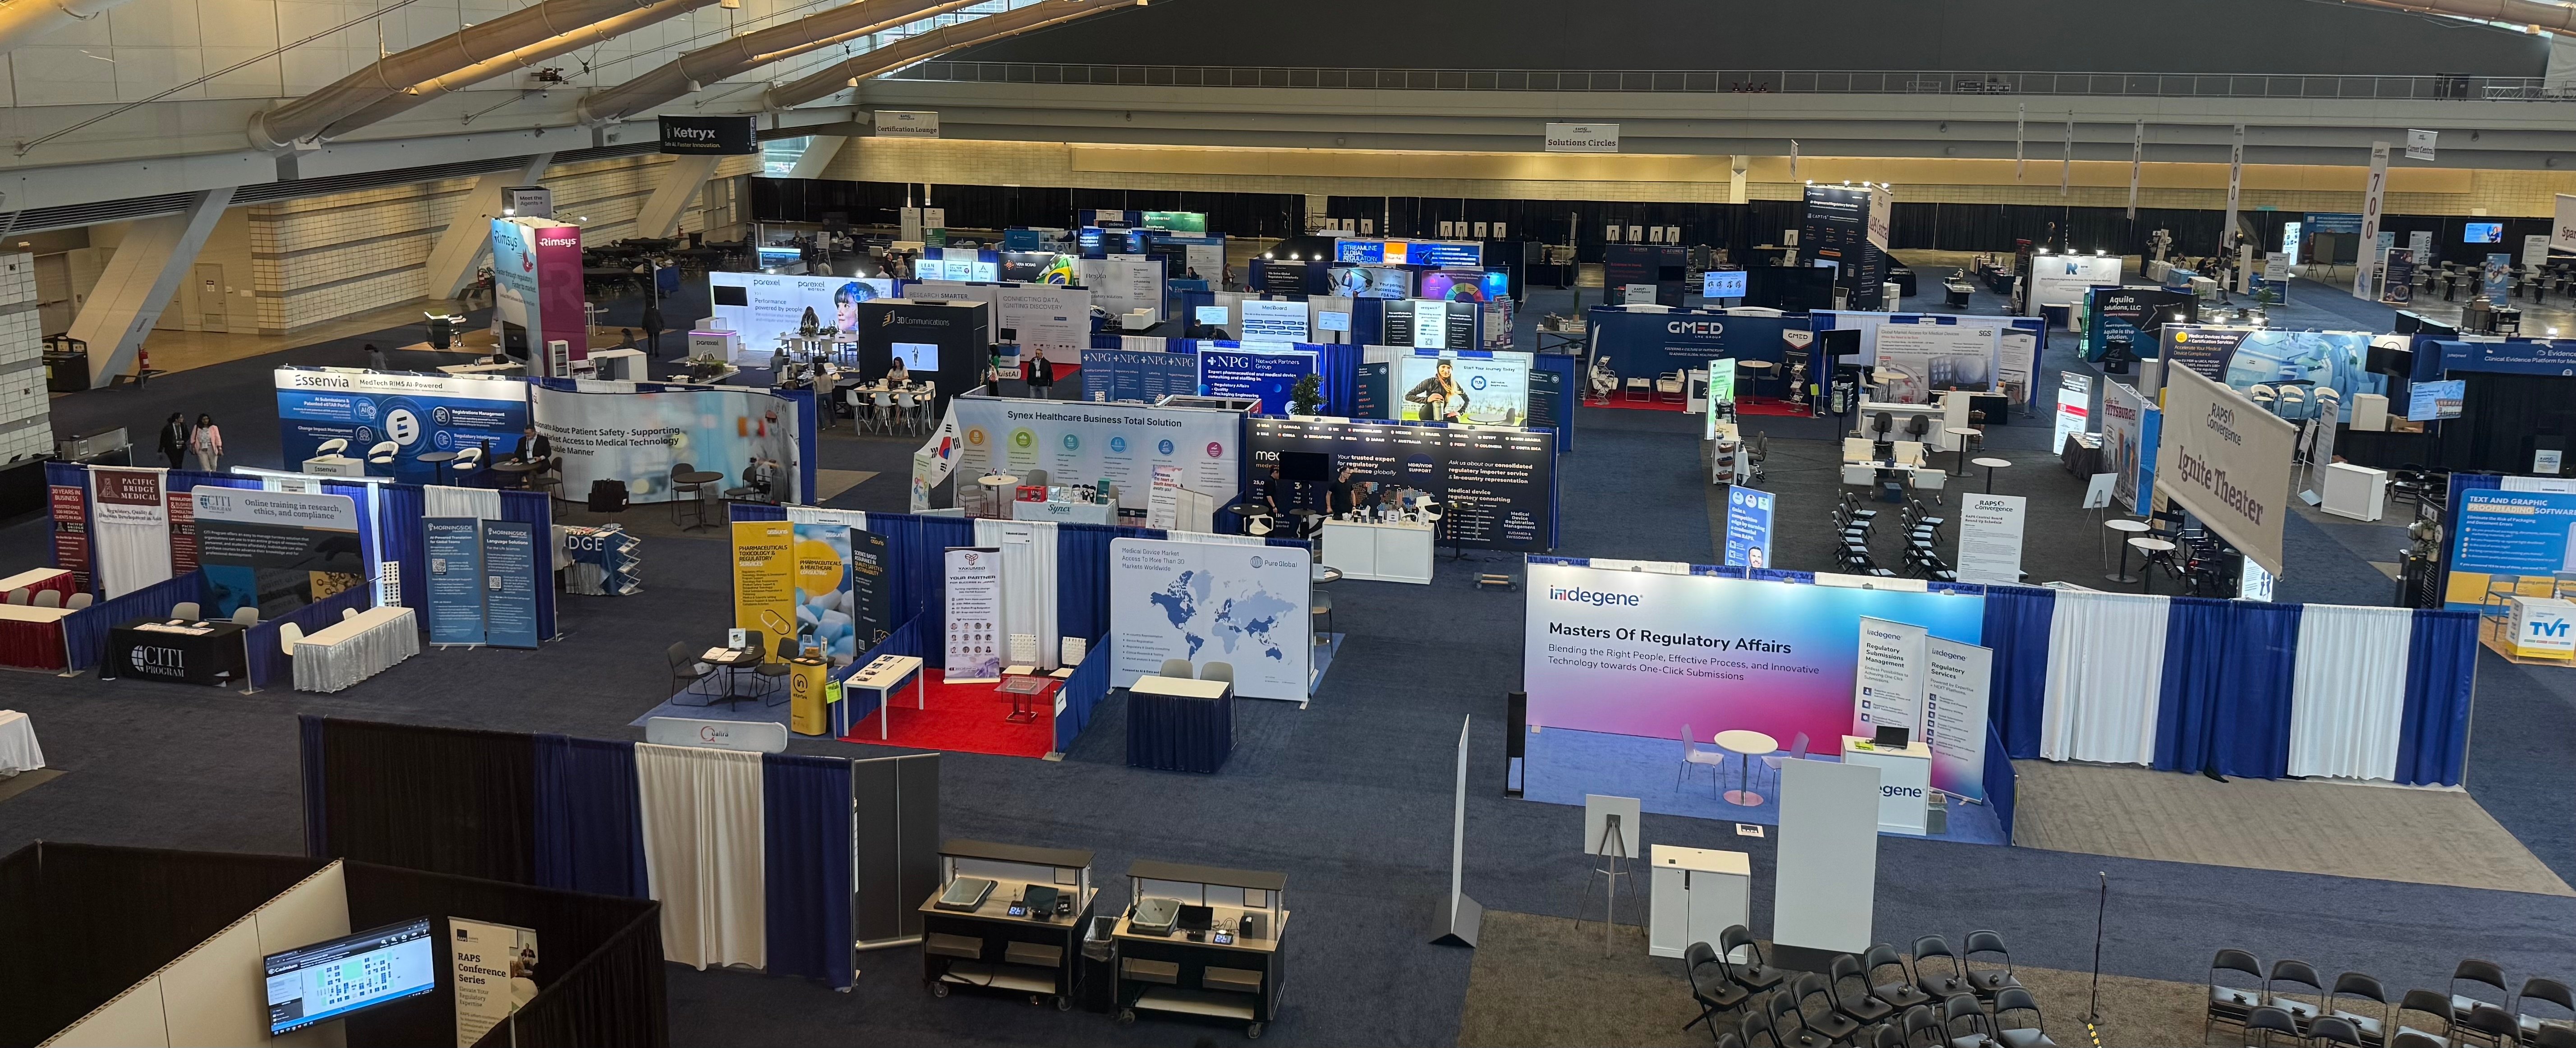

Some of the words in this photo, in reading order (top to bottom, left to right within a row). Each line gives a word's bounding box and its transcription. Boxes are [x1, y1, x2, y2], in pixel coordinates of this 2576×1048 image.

[674, 127, 715, 141] Ketryx
[2366, 173, 2380, 239] 700
[494, 231, 517, 251] Rimsys
[539, 238, 577, 247] Rimsys
[2110, 295, 2134, 305] Aquila
[1667, 321, 1723, 334] GMED
[1090, 353, 1111, 362] NPG
[1120, 354, 1139, 364] NPG
[1148, 355, 1167, 365] NPG
[1175, 357, 1194, 367] NPG
[1218, 356, 1248, 368] NPG
[296, 374, 349, 388] Essenvia
[2105, 404, 2136, 421] PITTSBURGH
[2212, 403, 2228, 423] RAPS
[1007, 411, 1033, 420] Synex
[1035, 412, 1081, 422] Healthcare
[1083, 414, 1122, 424] Business
[1124, 417, 1145, 425] Total
[1146, 418, 1182, 427] Solution
[552, 425, 570, 434] About
[571, 427, 598, 436] Patient
[599, 429, 625, 438] Safety
[631, 427, 680, 438] Supporting
[2207, 414, 2241, 446] Convergence
[563, 437, 584, 445] Access
[629, 437, 679, 446] Technology
[567, 447, 594, 456] Manner
[2178, 445, 2212, 489] Ignite
[2214, 468, 2263, 526] Theater
[208, 496, 230, 506] CITI
[270, 501, 298, 510] training
[308, 503, 341, 513] research,
[254, 508, 277, 517] ethics,
[294, 510, 335, 519] compliance
[1048, 504, 1071, 514] Synex
[1550, 585, 1641, 606] indegene
[2530, 618, 2570, 637] TVT
[1550, 622, 1610, 639] Masters
[1616, 628, 1636, 641] Of
[1641, 629, 1730, 651] Regulatory
[1735, 637, 1791, 654] Affairs
[1867, 628, 1901, 640] indegene
[1867, 642, 1900, 654] Regulatory
[144, 646, 184, 668] CITI
[1549, 644, 1588, 656] Blending
[1590, 648, 1604, 656] the
[1607, 648, 1631, 659] Right
[1633, 651, 1666, 662] People,
[1669, 654, 1707, 665] Effective
[1711, 658, 1748, 669] Process,
[1751, 660, 1768, 670] and
[1771, 663, 1819, 674] Innovative
[1866, 649, 1904, 661] Submissions
[1932, 648, 1966, 661] indegene
[1548, 656, 1597, 669] Technology
[1601, 660, 1636, 671] towards
[1640, 665, 1684, 675] One-Click
[1687, 668, 1744, 680] Submissions
[1866, 656, 1904, 668] Management
[1932, 662, 1965, 674] Regulatory
[146, 665, 184, 677] PROGRAM
[1931, 669, 1956, 679] Services
[458, 952, 481, 962] RAPS
[458, 964, 506, 977] Conference
[459, 974, 485, 984] Series
